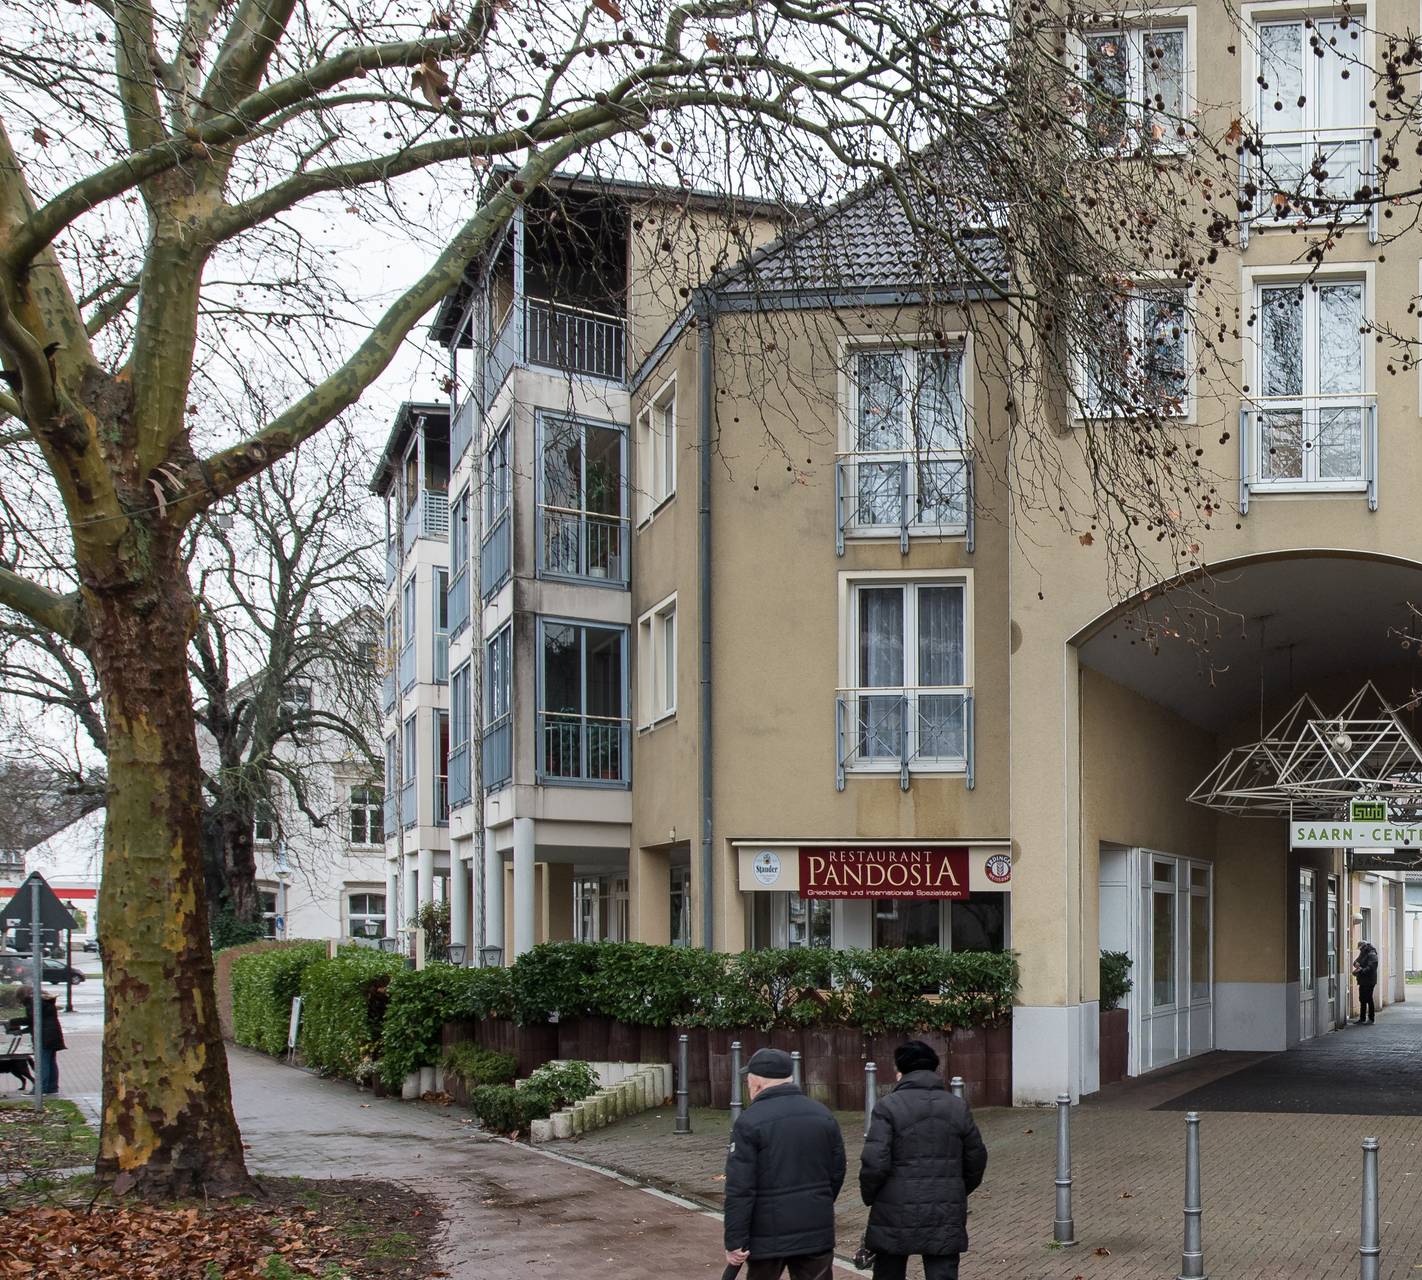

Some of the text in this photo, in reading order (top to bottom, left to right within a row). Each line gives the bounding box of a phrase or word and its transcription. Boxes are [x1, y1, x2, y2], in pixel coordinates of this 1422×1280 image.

[1297, 828, 1353, 841] SAARN
[829, 851, 932, 862] RESTAURANT
[808, 856, 960, 886] PANDOSIA
[916, 889, 961, 897] Spezialitäten
